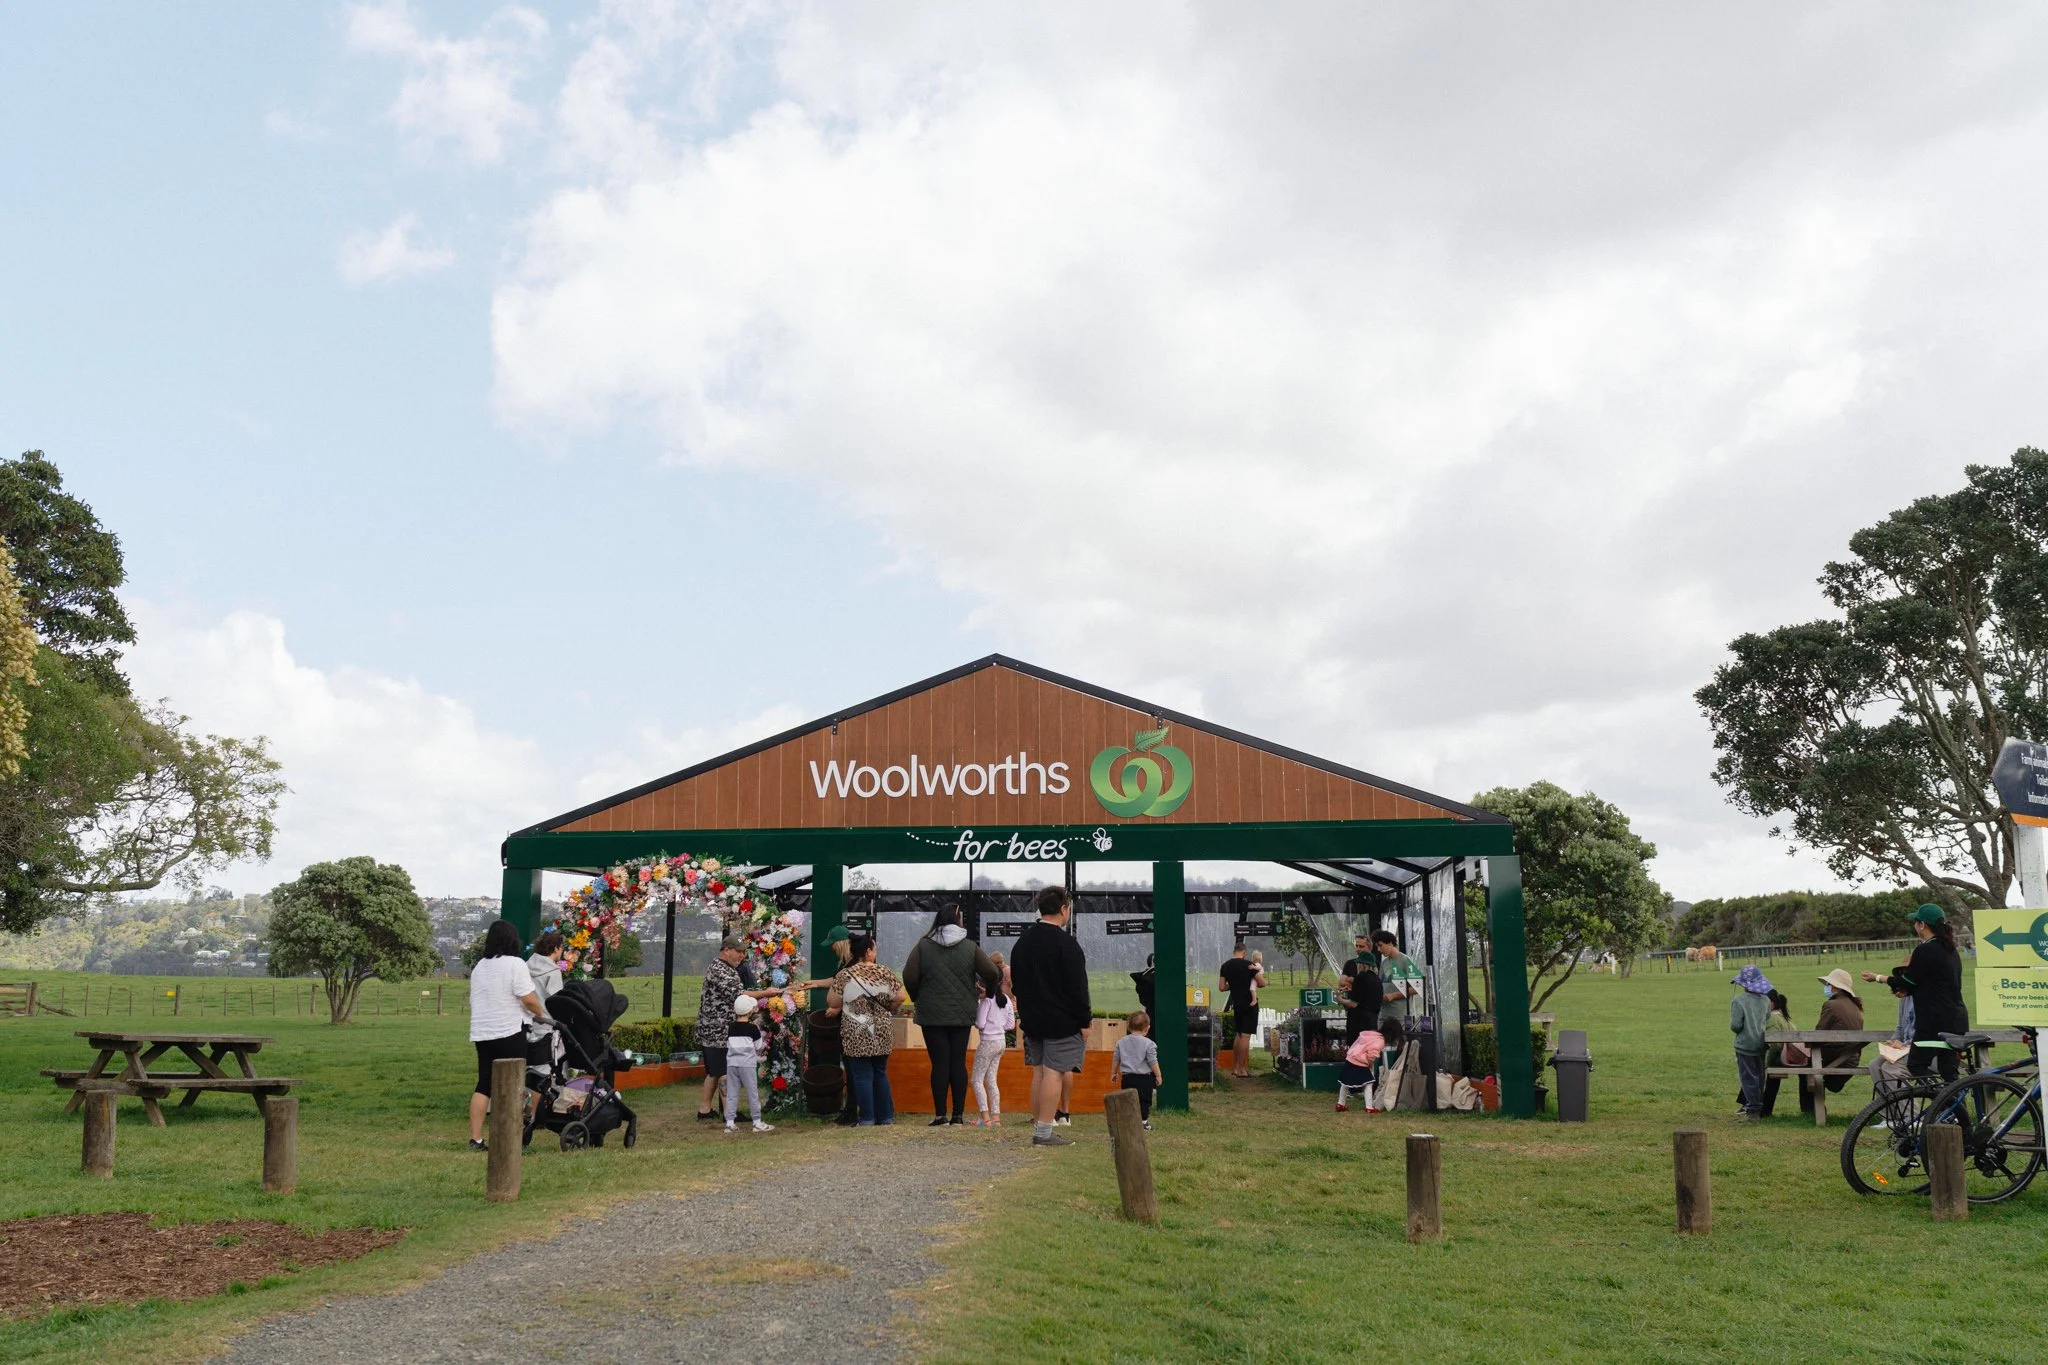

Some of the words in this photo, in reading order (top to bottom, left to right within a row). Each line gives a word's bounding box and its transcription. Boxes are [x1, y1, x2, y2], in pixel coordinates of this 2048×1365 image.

[810, 752, 1070, 798] Woolworths
[953, 830, 999, 861] for
[1007, 832, 1067, 859] bees
